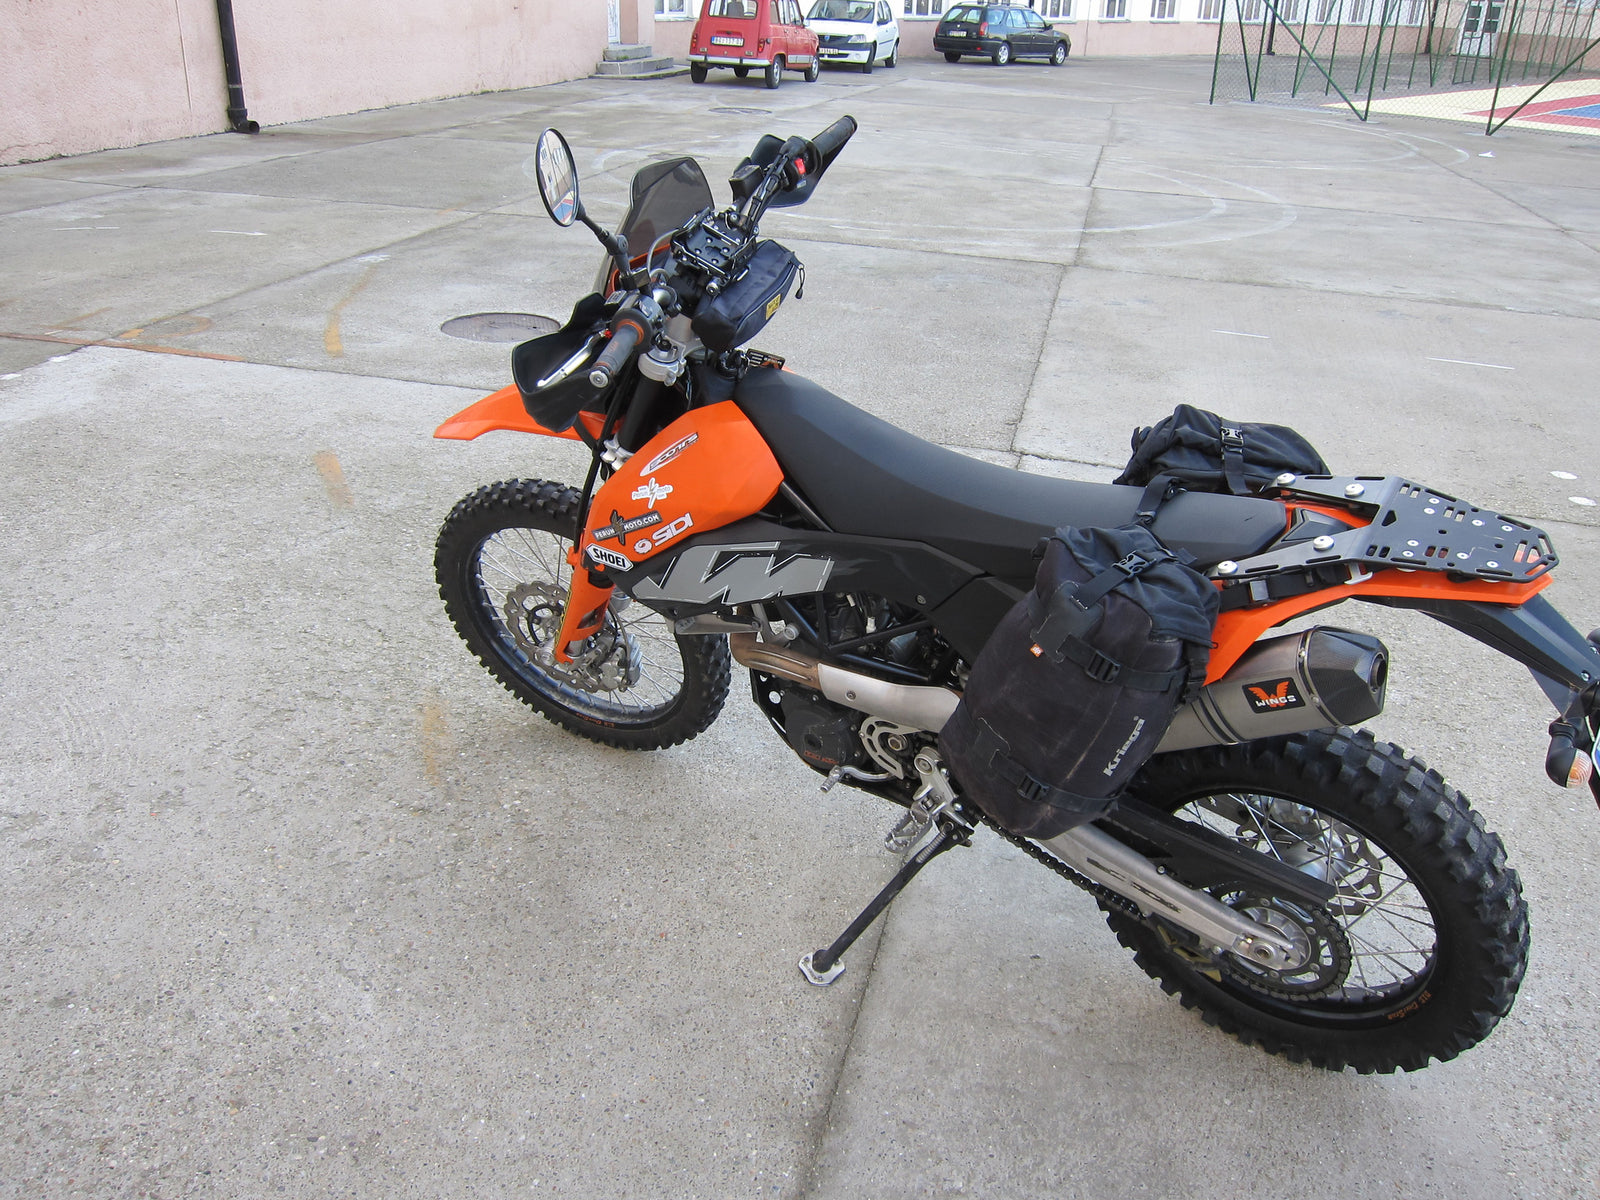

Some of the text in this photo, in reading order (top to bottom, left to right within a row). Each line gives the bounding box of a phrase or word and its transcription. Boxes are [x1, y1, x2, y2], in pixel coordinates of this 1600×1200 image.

[622, 513, 661, 532] MOTO.COM
[591, 547, 627, 568] SHOEI
[1255, 694, 1297, 707] WINGS
[1103, 715, 1146, 777] Kriega
